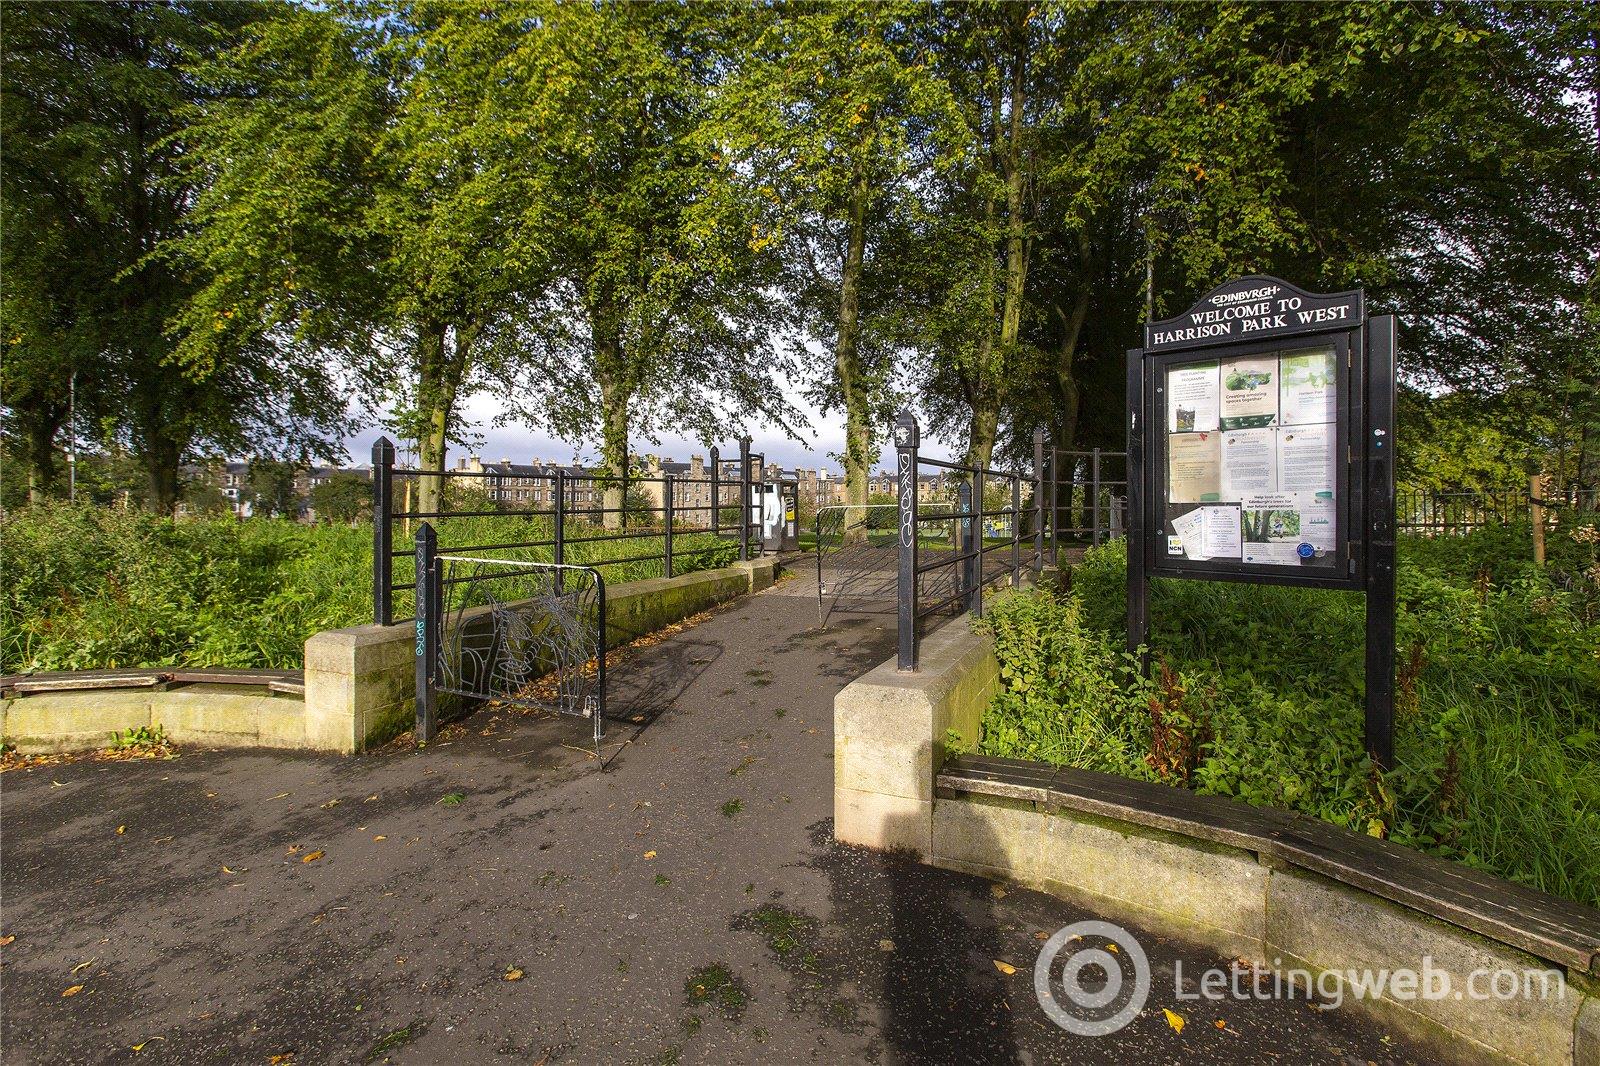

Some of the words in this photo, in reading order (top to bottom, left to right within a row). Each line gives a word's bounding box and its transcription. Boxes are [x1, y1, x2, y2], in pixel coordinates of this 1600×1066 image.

[1153, 322, 1231, 345] HARRISON
[1241, 314, 1287, 333] PARK
[1298, 305, 1349, 324] WEST
[1191, 302, 1270, 325] WELCOME
[1277, 297, 1302, 311] TO
